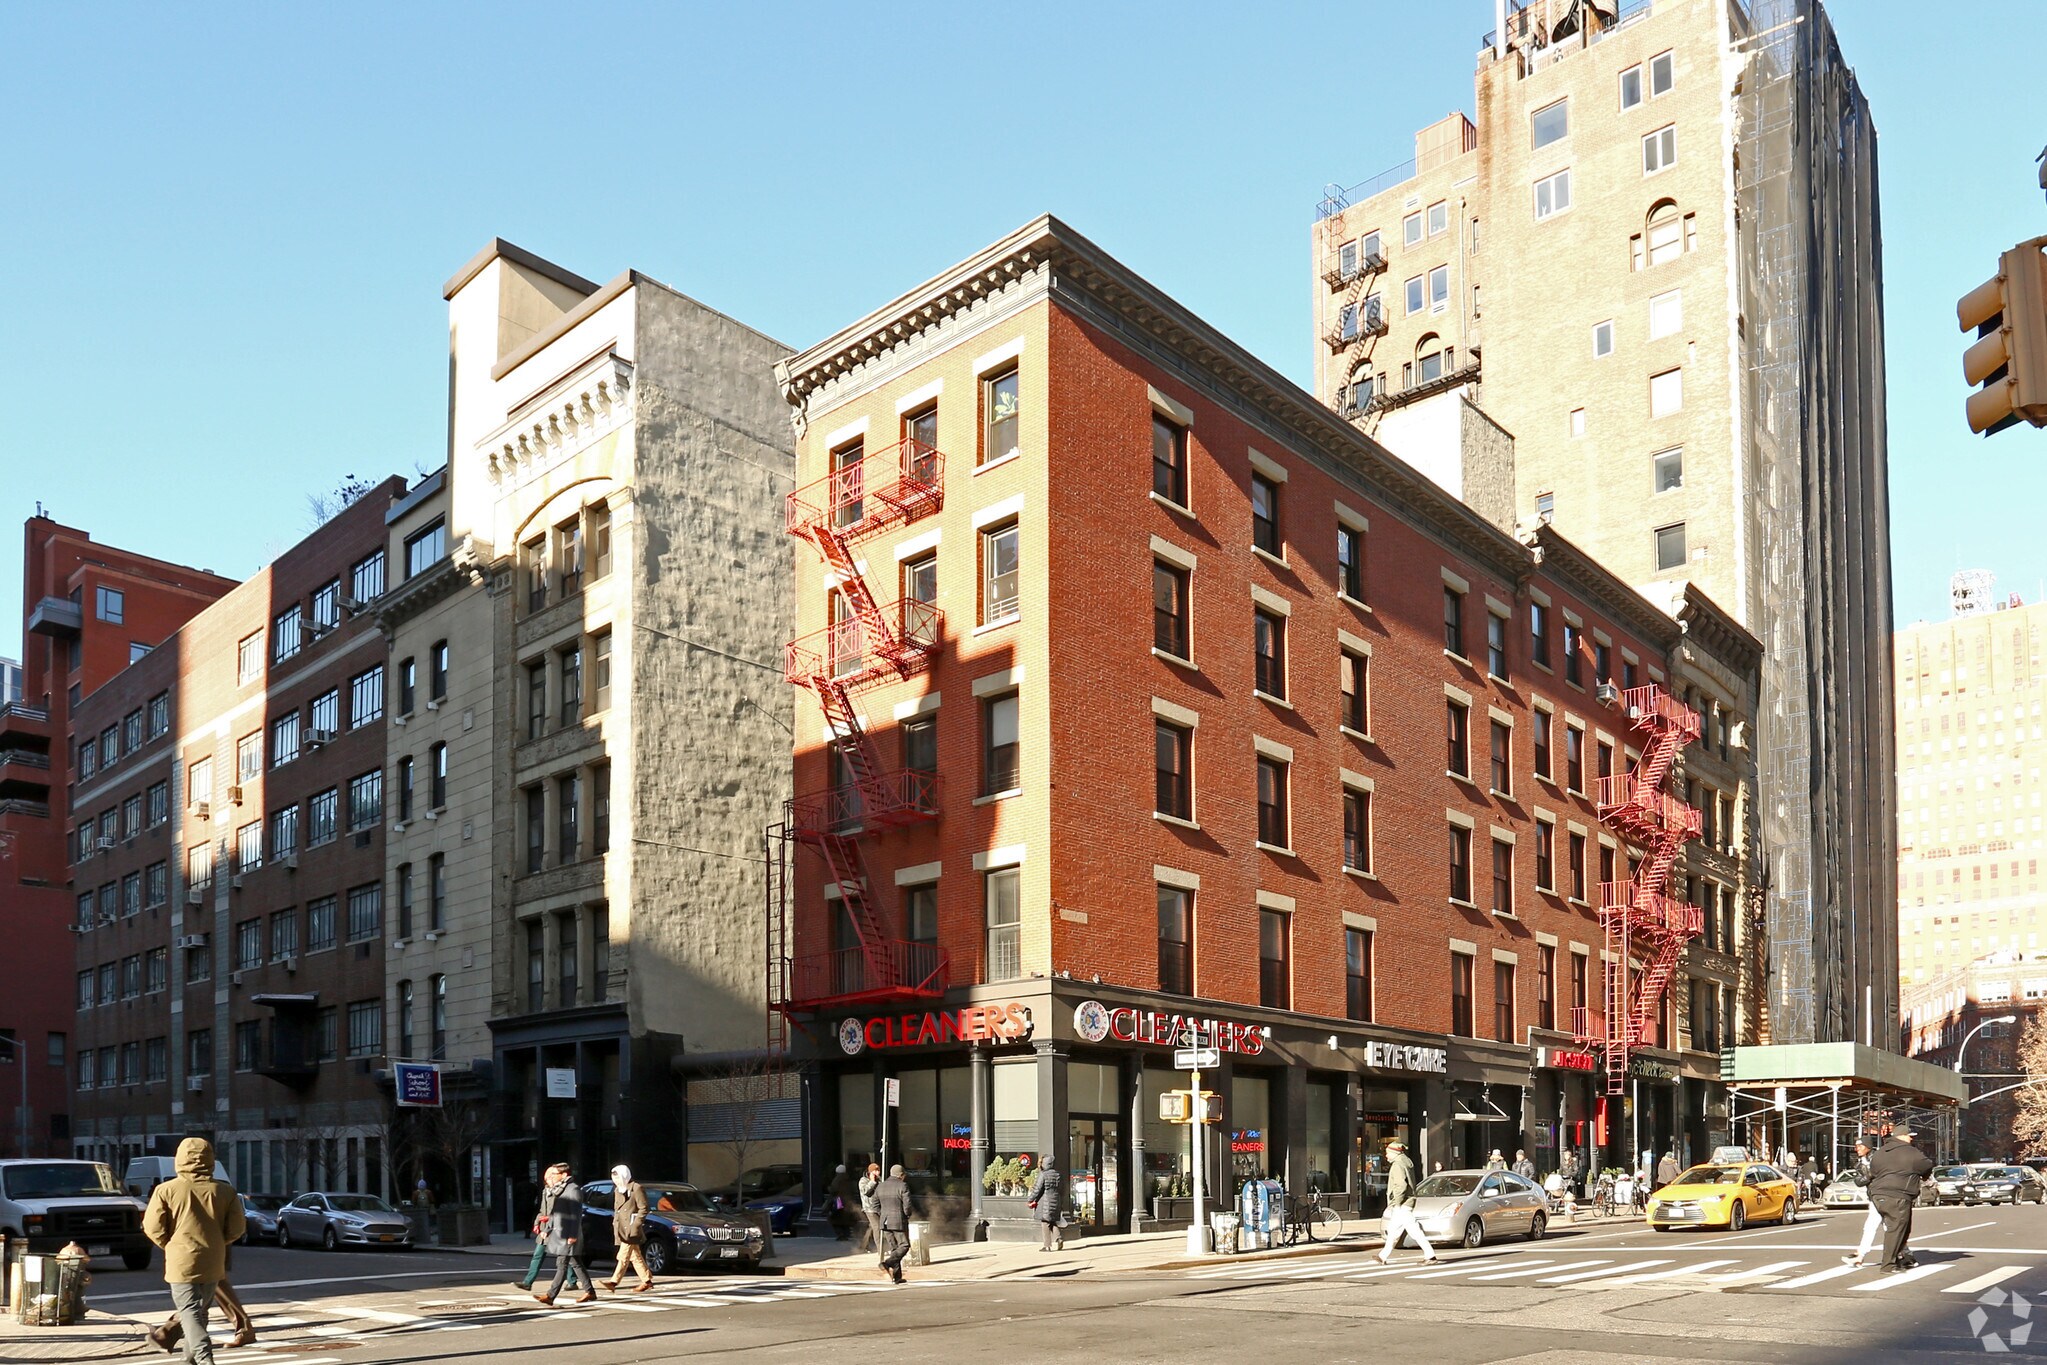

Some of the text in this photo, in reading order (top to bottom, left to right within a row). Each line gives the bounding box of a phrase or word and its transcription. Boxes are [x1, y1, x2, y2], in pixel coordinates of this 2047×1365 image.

[865, 1002, 1026, 1048] CLEANERS
[1081, 1025, 1105, 1039] CLEANERS
[1110, 1007, 1265, 1055] CLEANERS
[841, 1040, 862, 1053] CLEANERS
[1367, 1041, 1447, 1073] EYE CARE
[1231, 1141, 1265, 1152] EANERS
